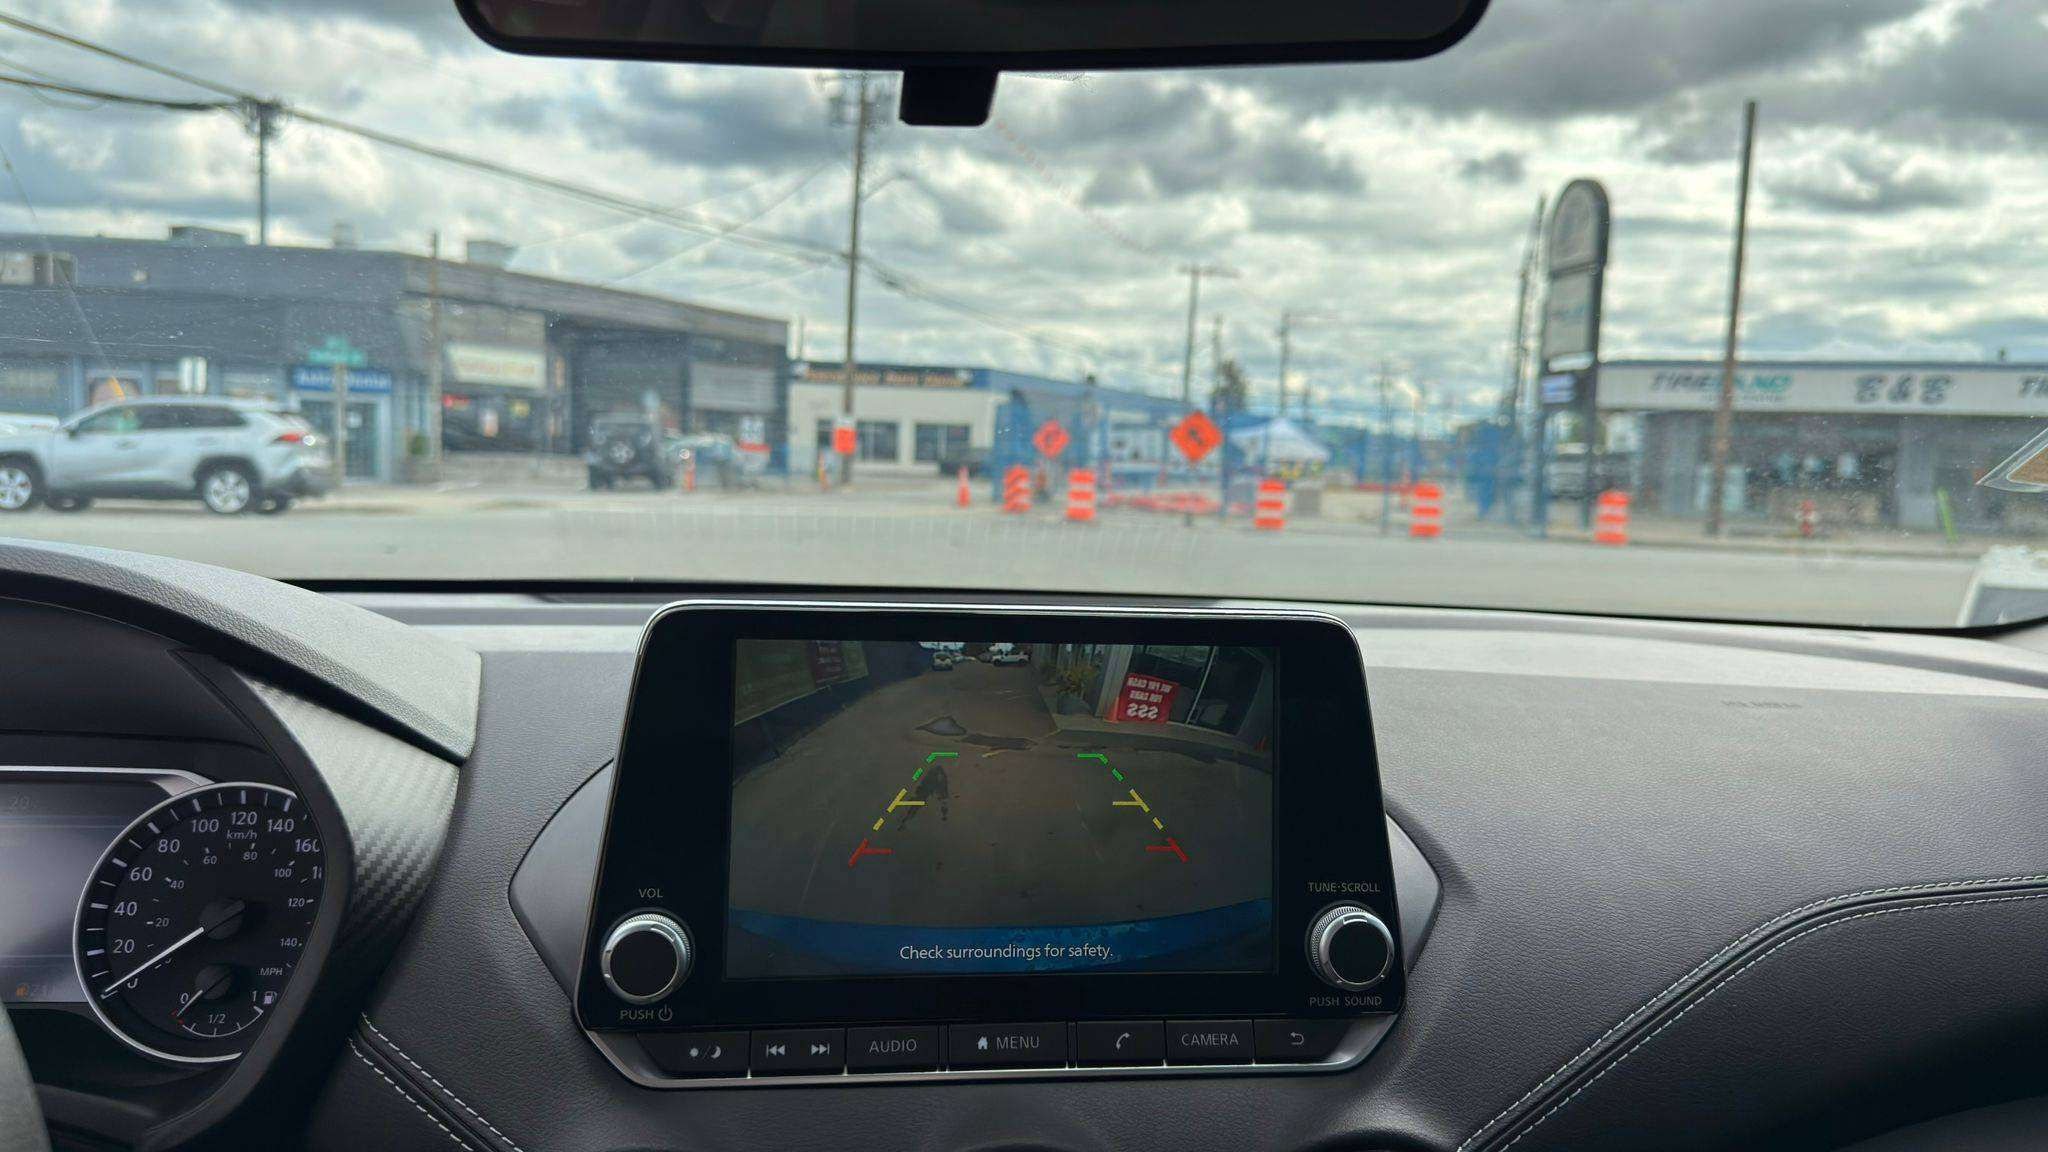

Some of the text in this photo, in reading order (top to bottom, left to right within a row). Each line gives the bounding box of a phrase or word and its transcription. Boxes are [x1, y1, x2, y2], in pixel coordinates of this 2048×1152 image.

[231, 811, 257, 825] 120
[191, 819, 219, 833] 100
[267, 818, 294, 832] 140
[226, 830, 257, 841] km/h
[158, 838, 181, 852] 80
[203, 855, 217, 864] 60
[243, 851, 257, 860] 80
[130, 867, 152, 881] 60
[274, 868, 291, 878] 100
[170, 880, 184, 889] 40
[639, 887, 663, 899] VOL
[114, 901, 137, 916] 40
[288, 898, 305, 907] 120
[155, 918, 169, 927] 20
[113, 939, 135, 953] 20
[280, 937, 297, 947] 140
[900, 942, 1113, 961] Check surroundings for safety.
[260, 967, 283, 976] MPH
[180, 992, 189, 1004] 0
[252, 991, 257, 1001] 1
[1309, 995, 1382, 1007] PUSH SOUND
[208, 1013, 226, 1024] 1/2
[620, 1009, 654, 1021] PUSH
[869, 1038, 918, 1053] AUDIO
[996, 1035, 1040, 1049] MENU
[1181, 1033, 1239, 1046] CAMERA
